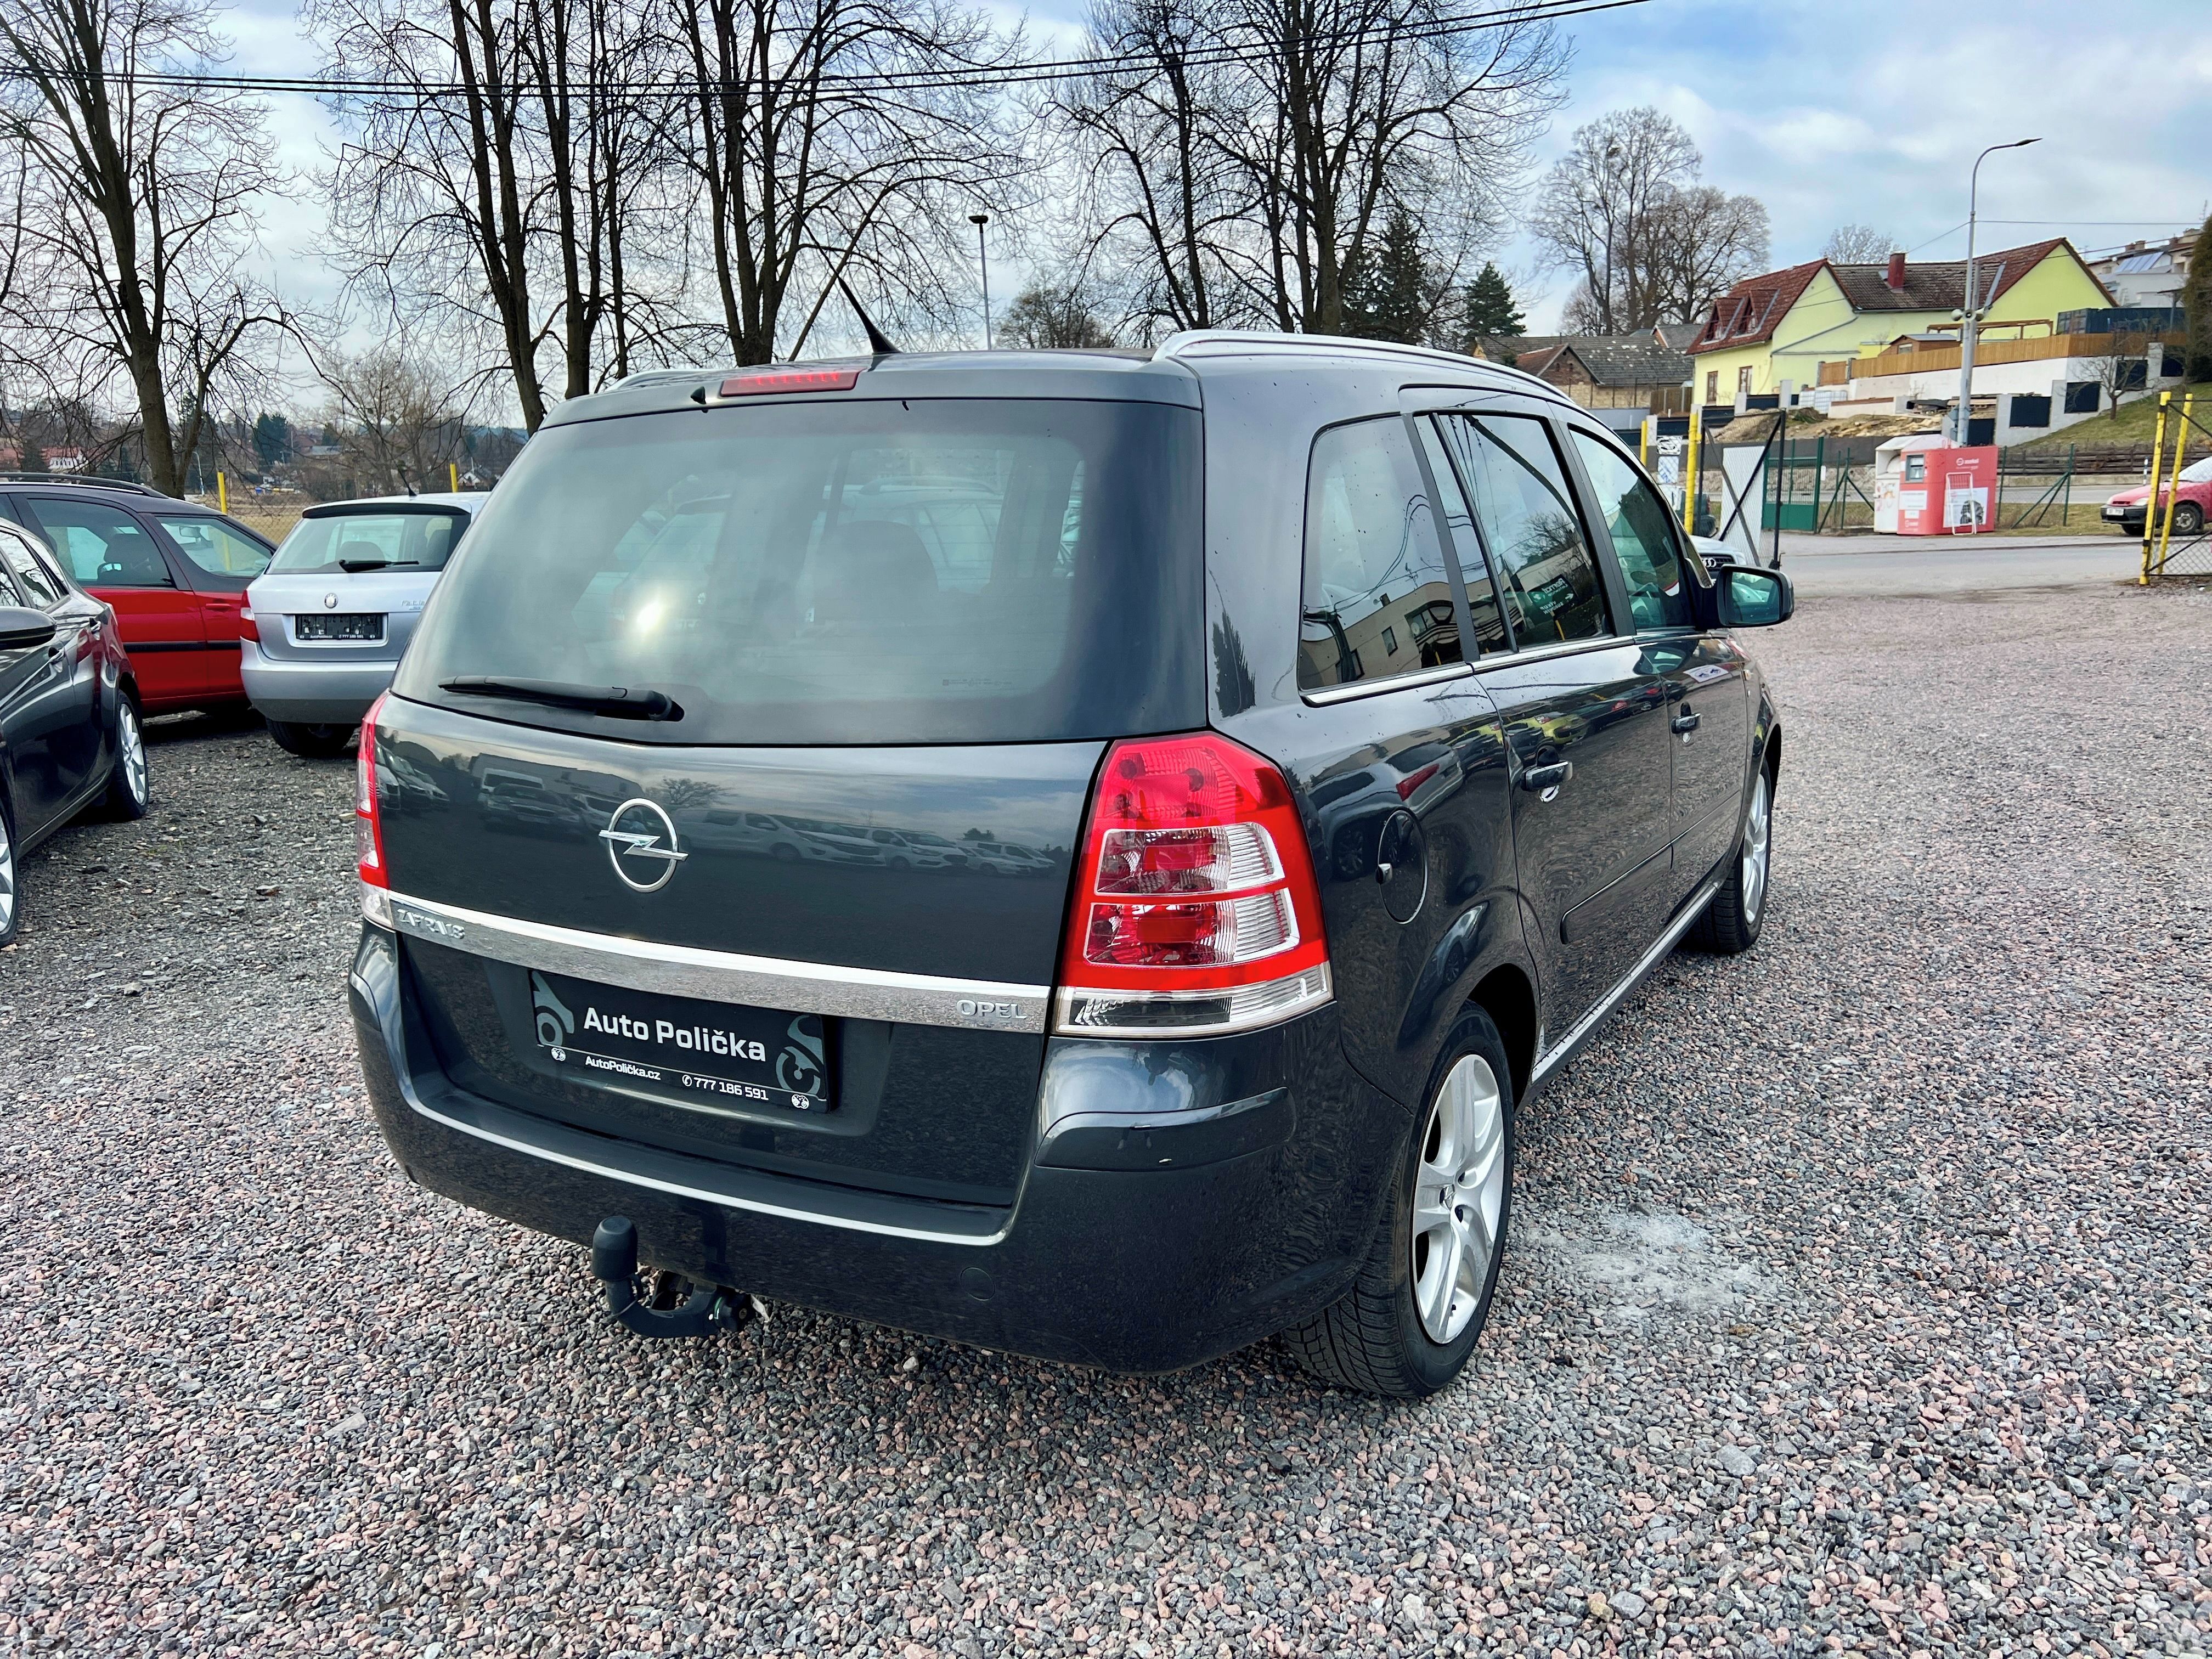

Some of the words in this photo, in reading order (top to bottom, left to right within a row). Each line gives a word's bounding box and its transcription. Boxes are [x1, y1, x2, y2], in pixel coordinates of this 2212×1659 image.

[956, 999, 1027, 1019] OPEL
[584, 1007, 649, 1041] Auto
[656, 1020, 766, 1062] Polička
[585, 1056, 661, 1080] AutoPolička.cz
[694, 1077, 716, 1091] 777
[719, 1082, 743, 1096] 186
[745, 1086, 769, 1101] 591
